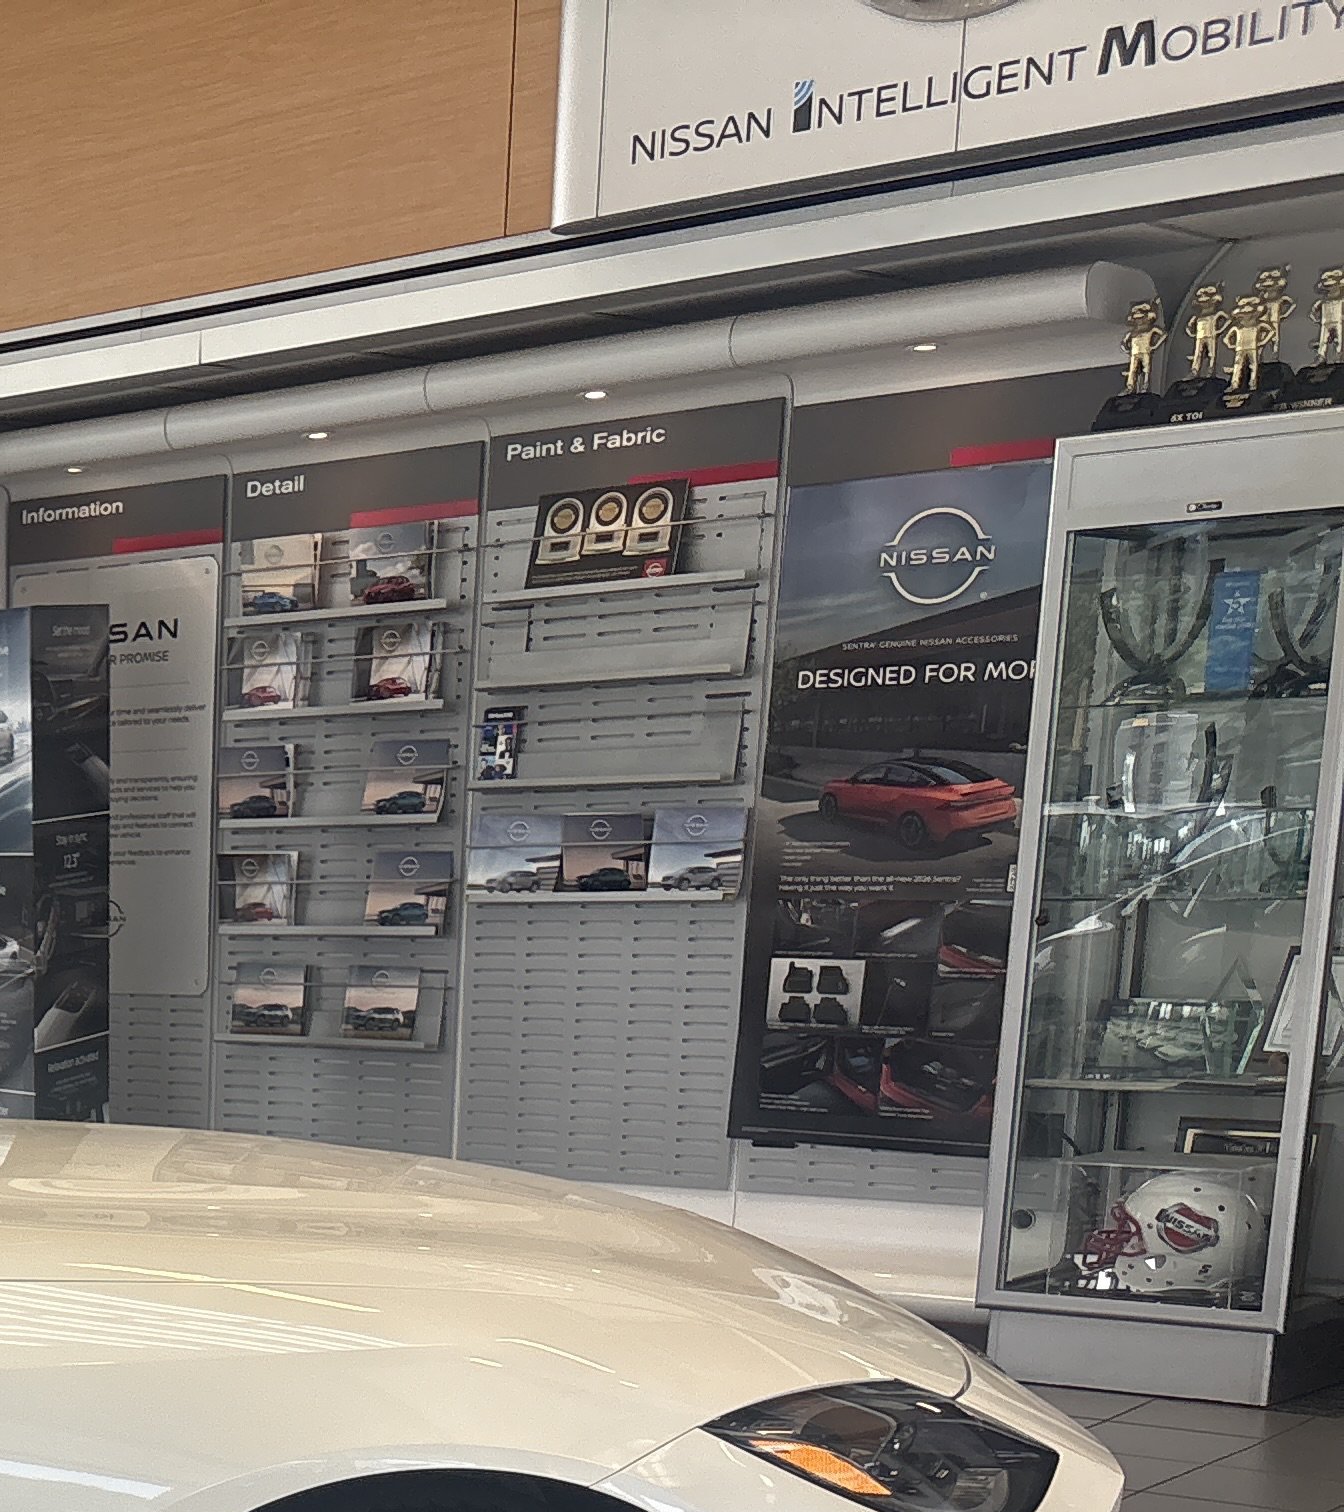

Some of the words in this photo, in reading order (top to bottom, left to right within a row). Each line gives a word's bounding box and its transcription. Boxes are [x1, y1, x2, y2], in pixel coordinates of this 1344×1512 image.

[631, 108, 773, 165] NISSAN
[792, 45, 1088, 134] INTELLIGENT
[1096, 0, 1344, 76] MOBILITY
[506, 439, 564, 462] Paint
[570, 437, 585, 453] &
[592, 427, 666, 450] Fabric
[246, 475, 305, 498] Detail
[21, 500, 124, 525] Information
[880, 545, 995, 567] NISSAN
[920, 637, 953, 647] NISSAN
[119, 650, 169, 664] PROMISE
[797, 665, 916, 689] DESIGNED
[924, 662, 976, 683] FOR
